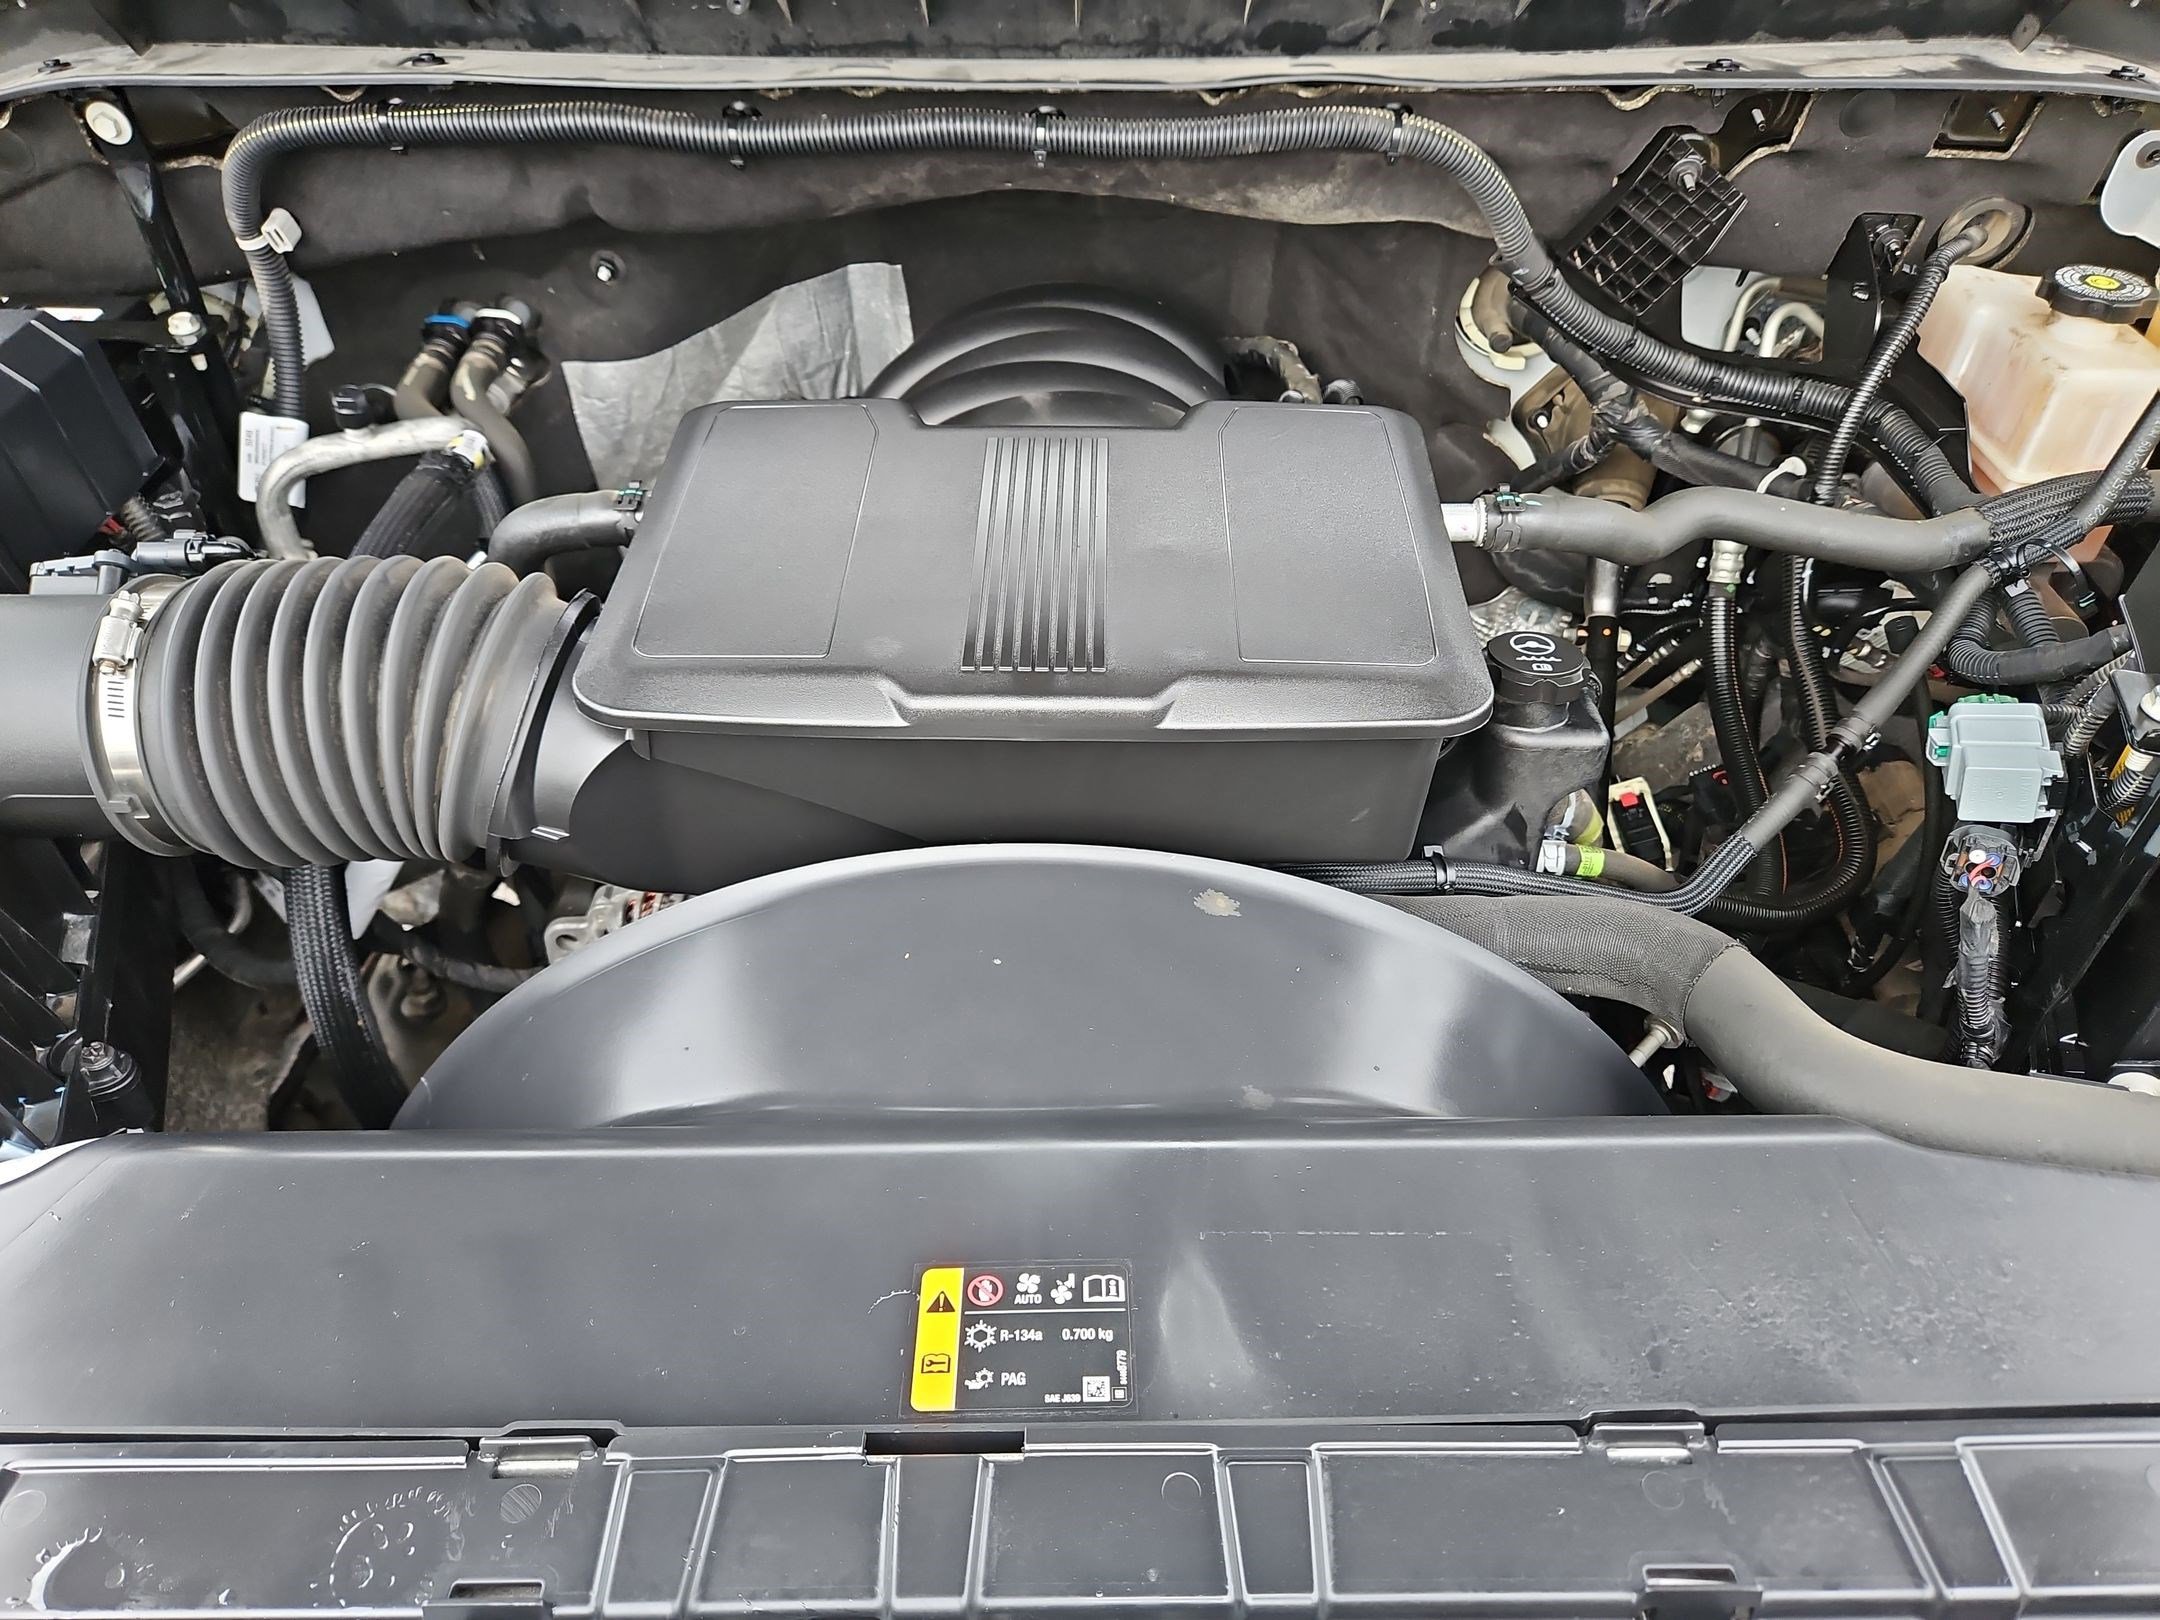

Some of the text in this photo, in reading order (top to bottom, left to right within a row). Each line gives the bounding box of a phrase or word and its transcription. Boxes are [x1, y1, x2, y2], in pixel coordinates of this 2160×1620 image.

[2104, 477, 2127, 503] 13:53
[1014, 1294, 1042, 1305] AUTO
[1000, 1328, 1113, 1342] R-134a 0.700 kg
[1000, 1372, 1026, 1386] PAG
[1044, 1393, 1061, 1403] SAE
